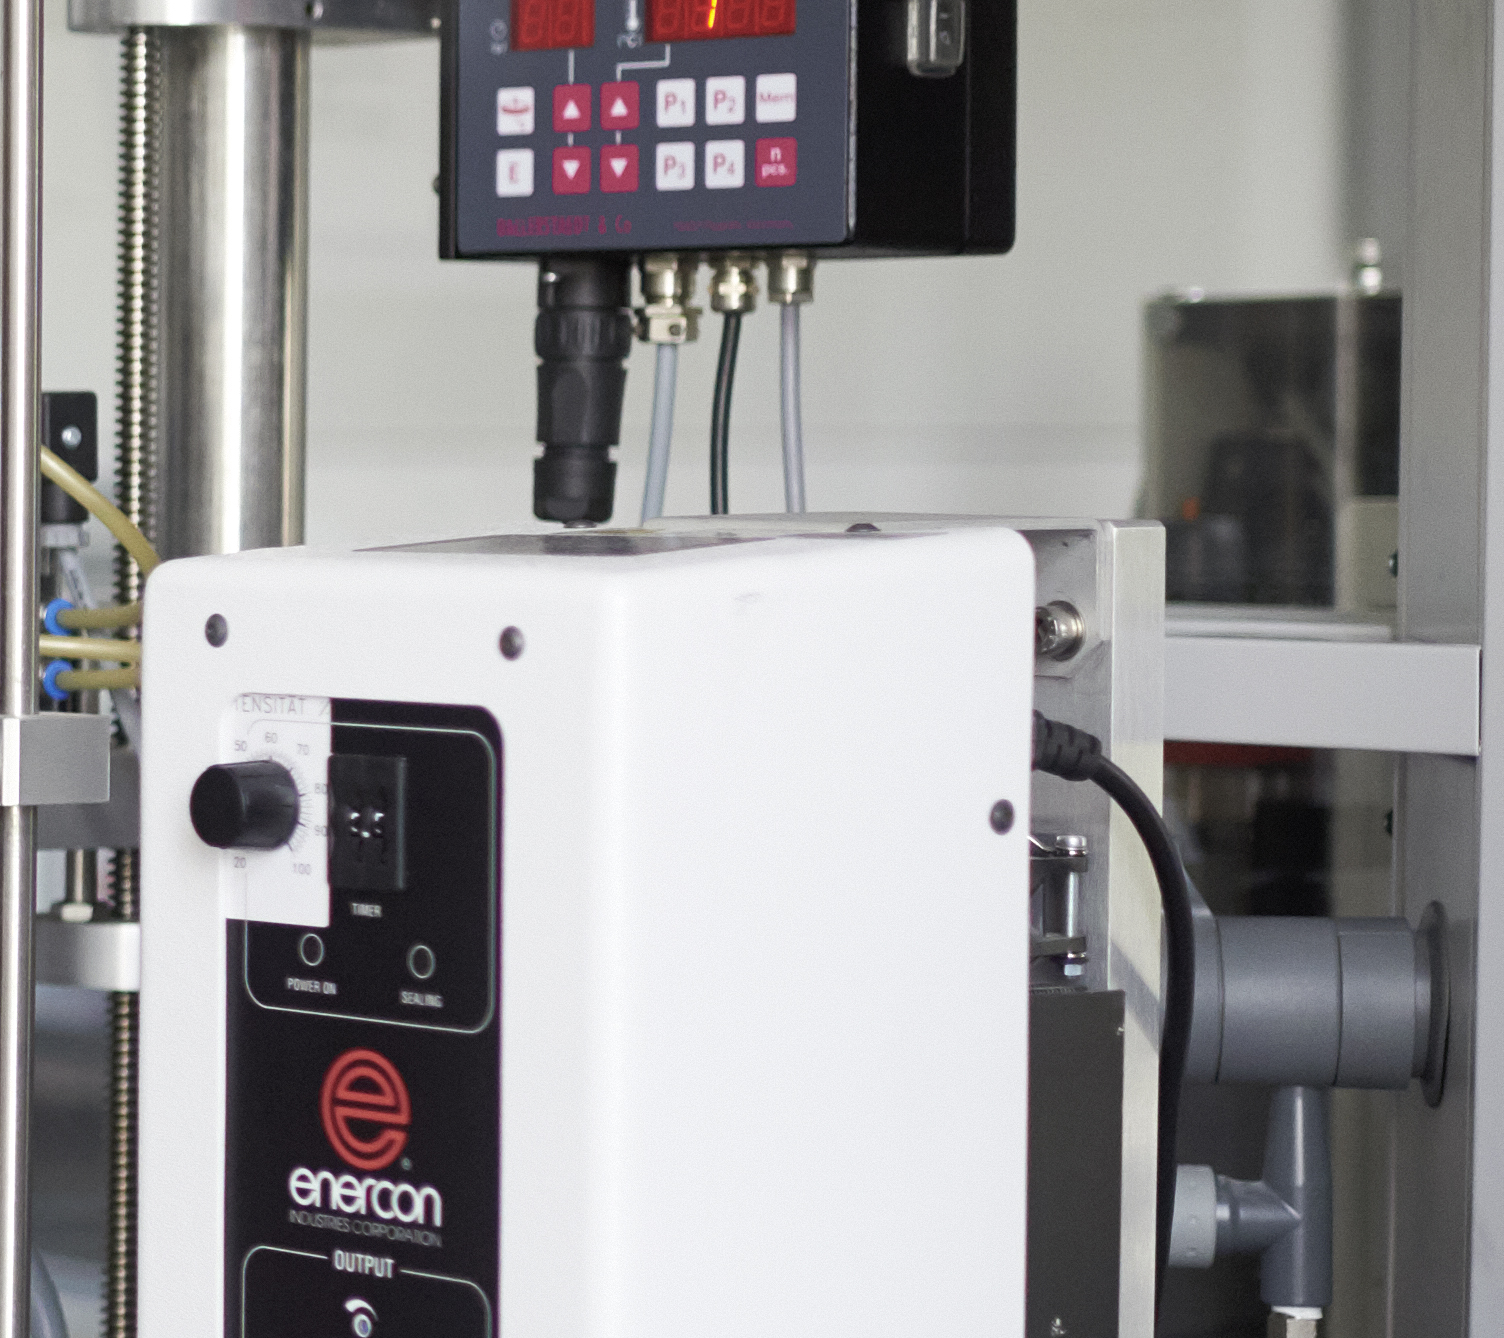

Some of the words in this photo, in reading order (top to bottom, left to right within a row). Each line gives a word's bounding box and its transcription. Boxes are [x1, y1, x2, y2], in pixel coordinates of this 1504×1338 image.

[351, 902, 382, 918] TIMER
[287, 977, 320, 994] POWER
[323, 982, 337, 995] ON
[400, 991, 443, 1008] SEALING
[289, 1167, 443, 1228] enercon
[289, 1209, 350, 1233] INDUSTRIES
[352, 1219, 442, 1247] CORPORATION
[334, 1249, 395, 1278] OUTPUT
